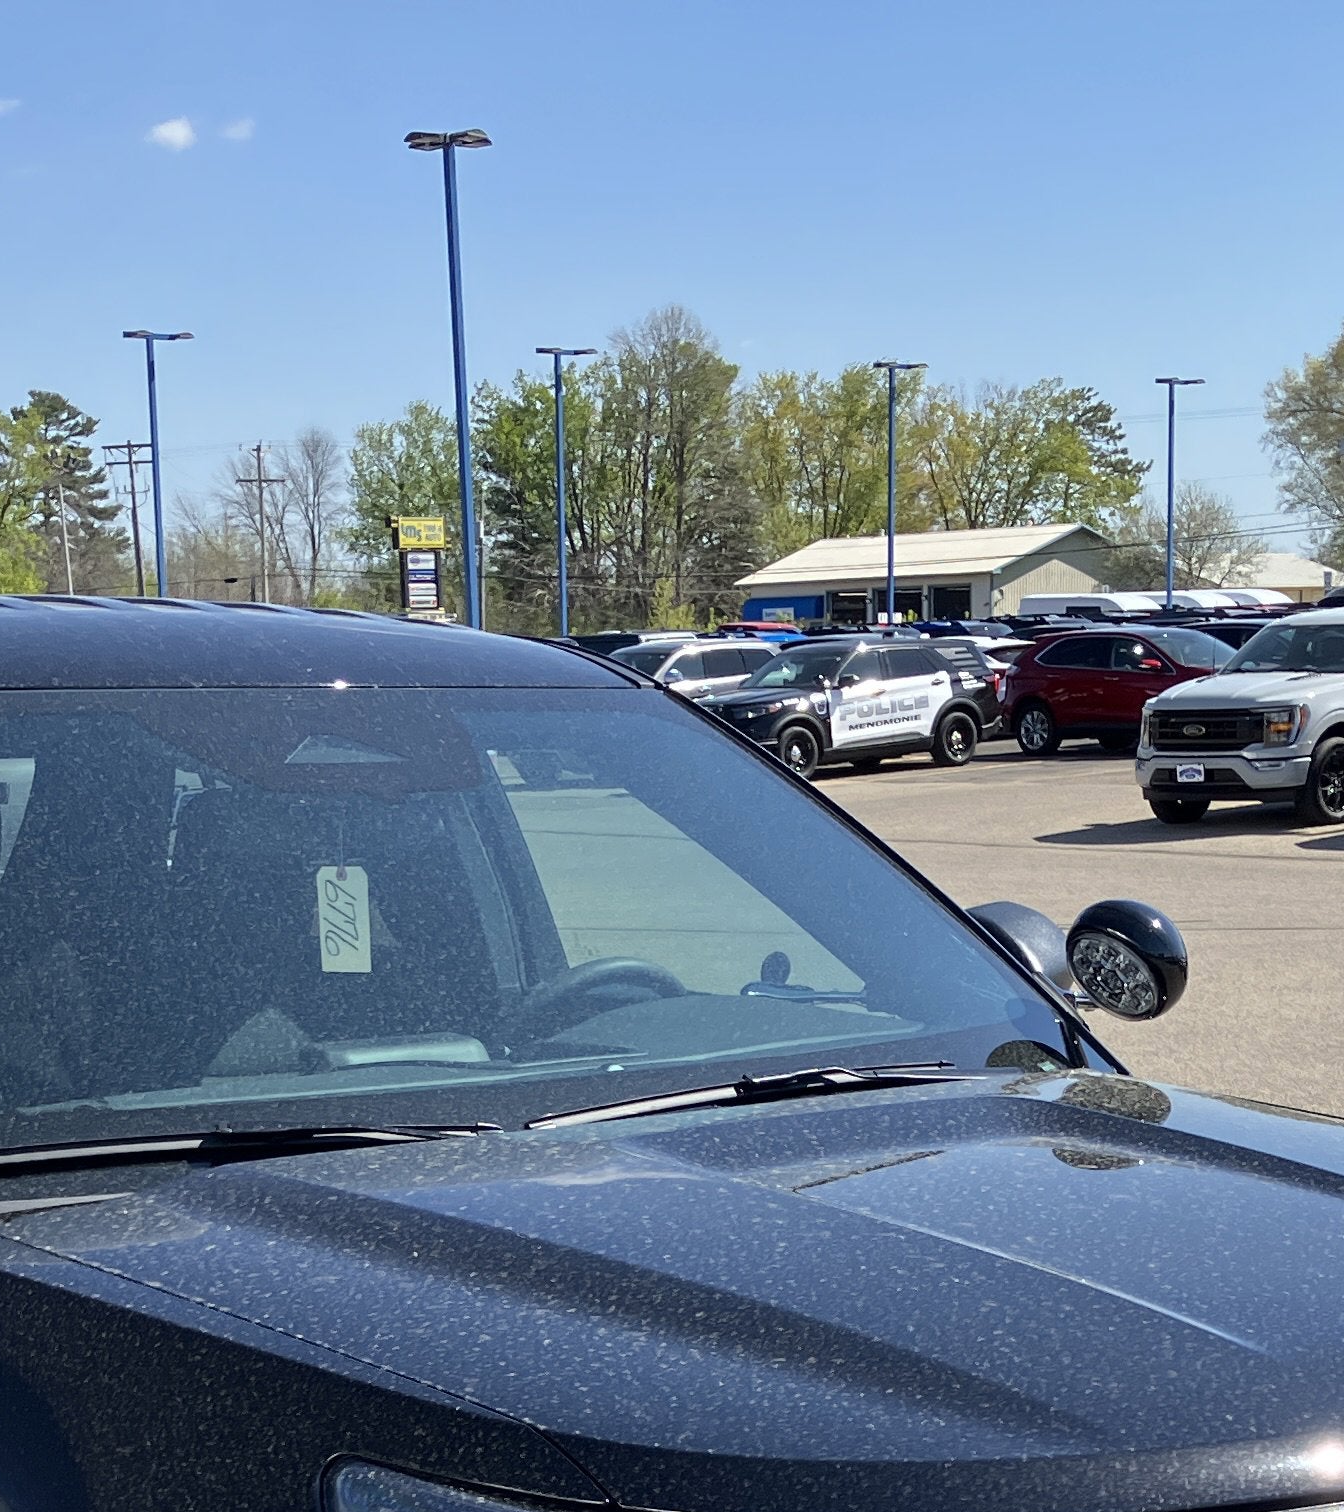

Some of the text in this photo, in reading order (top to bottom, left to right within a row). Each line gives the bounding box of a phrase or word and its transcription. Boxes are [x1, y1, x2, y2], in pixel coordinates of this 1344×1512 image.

[839, 694, 930, 722] POLICE
[848, 714, 922, 732] MENOMONIE
[324, 879, 359, 956] 6776
